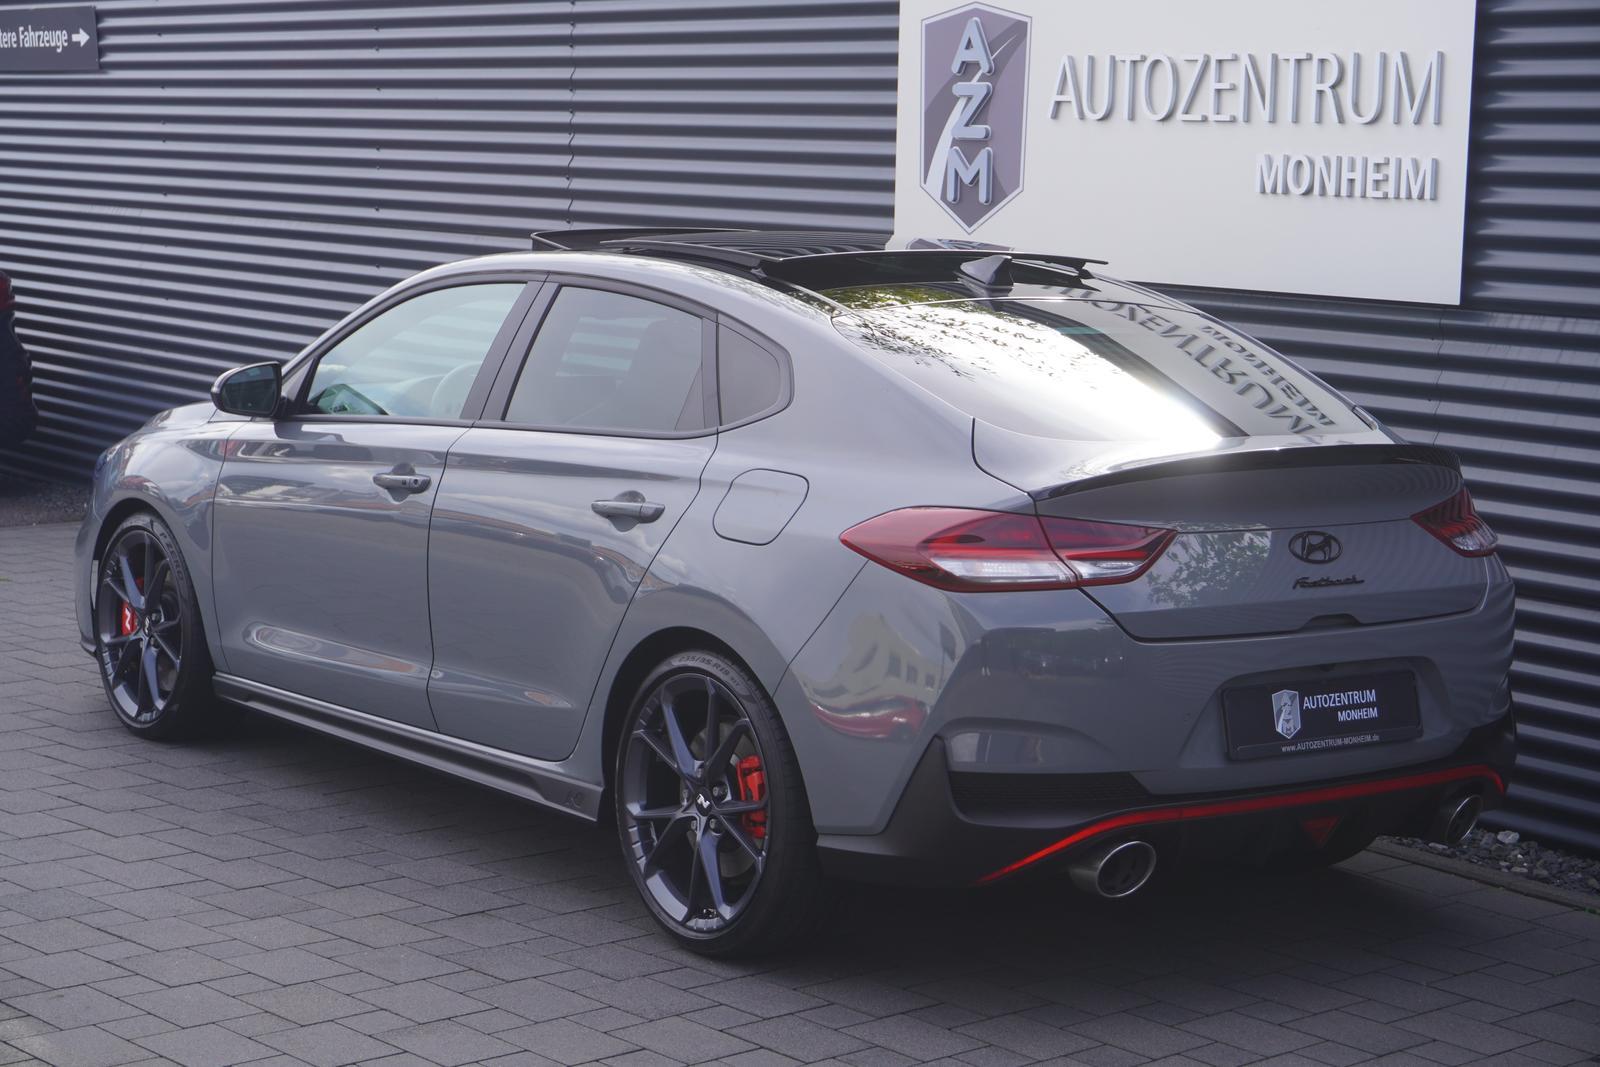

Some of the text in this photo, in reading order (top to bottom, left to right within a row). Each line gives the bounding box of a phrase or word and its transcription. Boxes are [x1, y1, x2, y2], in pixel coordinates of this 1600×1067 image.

[19, 25, 68, 53] Fahrzeuge
[1048, 50, 1444, 126] AUTOZENTRUM
[1255, 153, 1439, 201] MONHEIM
[1303, 688, 1377, 710] AUTOZENTRUM
[1337, 706, 1379, 722] MONHEIM
[1281, 733, 1380, 753] www.AUTOZENTRUM-MONHEIM.de
